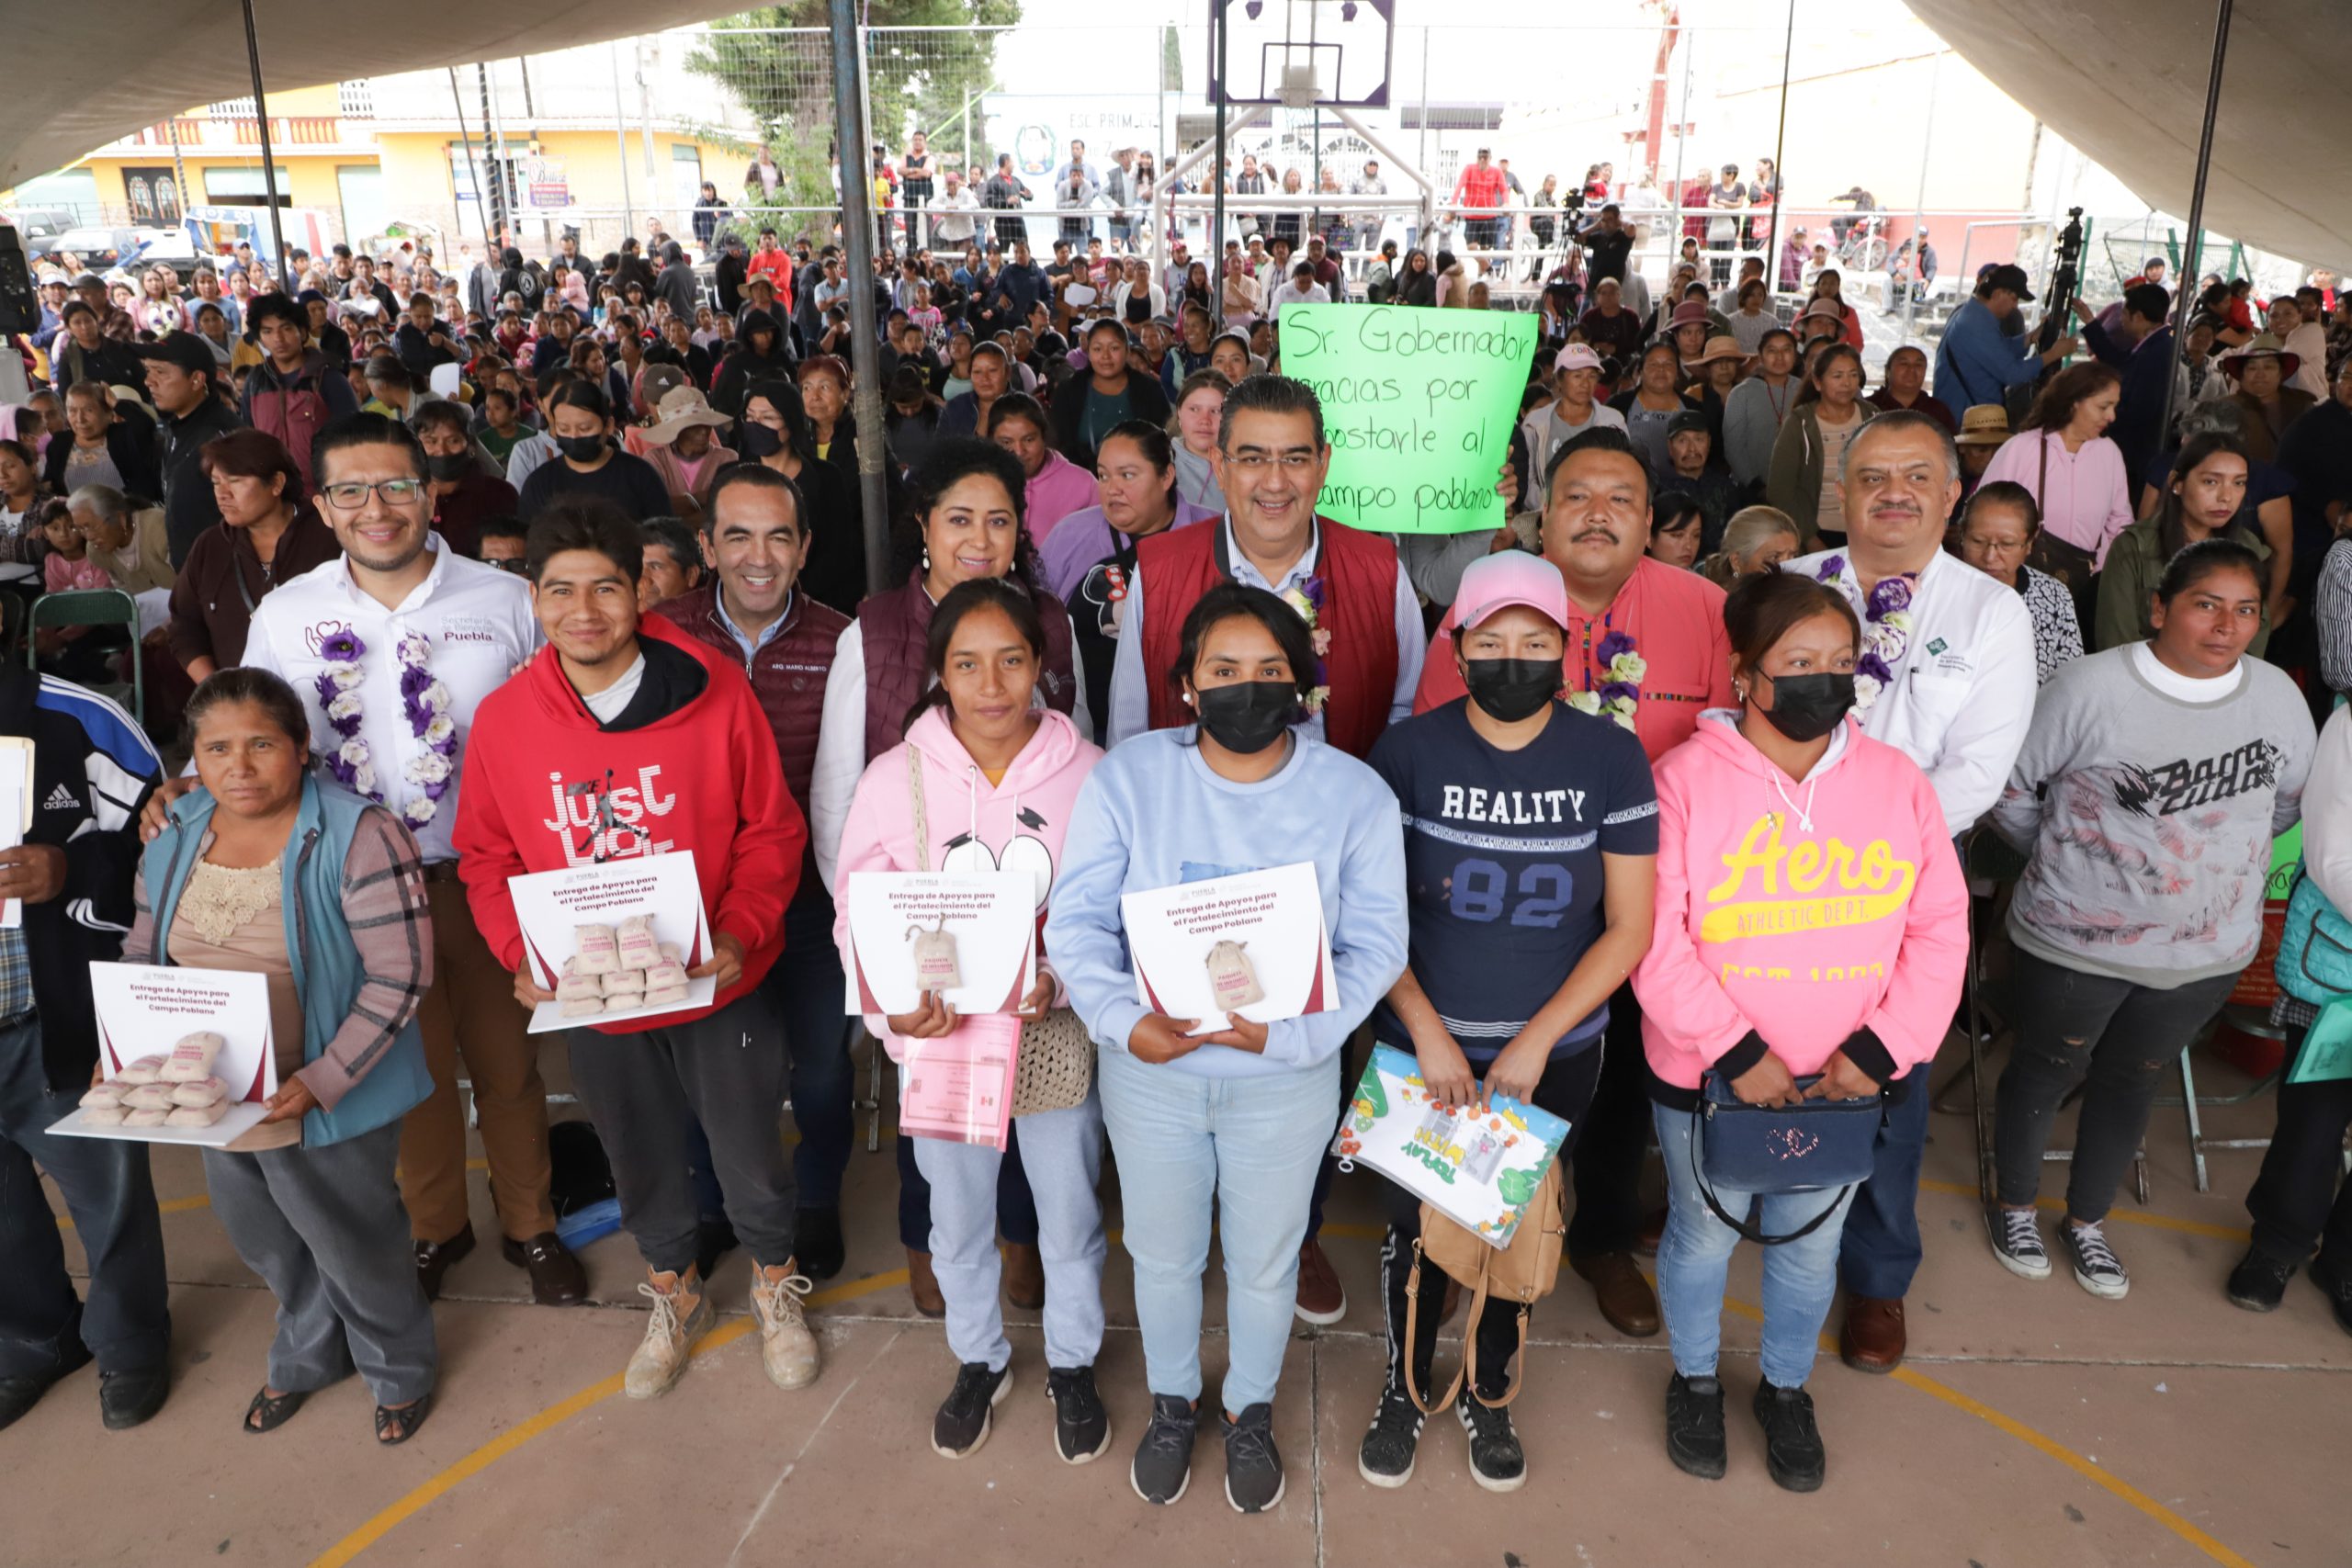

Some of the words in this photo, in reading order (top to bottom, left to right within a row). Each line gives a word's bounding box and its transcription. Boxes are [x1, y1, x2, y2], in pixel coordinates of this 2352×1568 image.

[1287, 310, 1339, 357] Sr.
[1359, 308, 1529, 361] Gobernador
[1426, 378, 1477, 417] por
[1463, 417, 1486, 456] al
[1414, 477, 1493, 528] poblano
[445, 632, 492, 641] Puebla
[43, 797, 80, 810] adidas
[1442, 785, 1586, 824] REALITY
[1707, 812, 1896, 902] Aero
[552, 887, 587, 897] Entrega
[602, 879, 635, 889] Apoyos
[636, 875, 657, 886] para
[569, 889, 639, 904] Fortalecimiento
[641, 885, 654, 893] del
[889, 893, 924, 901] Entrega
[974, 893, 995, 901] para
[1450, 858, 1573, 928] 82
[574, 903, 606, 911] Campo
[607, 897, 644, 907] Poblano
[1166, 906, 1204, 917] Entrega
[1218, 896, 1253, 908] Apoyos
[1255, 891, 1277, 903] para
[1173, 919, 1182, 927] el
[1183, 906, 1259, 925] Fortalecimiento
[1260, 902, 1274, 911] del
[906, 912, 939, 921] Campo
[1189, 923, 1223, 934] Campo
[1224, 917, 1263, 928] Poblano
[1737, 906, 1814, 933] ATHLETIC
[1824, 899, 1870, 923] DEPT.
[130, 984, 164, 994] Entrega
[176, 987, 209, 996] Apoyos
[144, 995, 212, 1005] Fortalecimiento
[149, 1004, 179, 1014] Campo
[180, 1007, 215, 1015] Poblano
